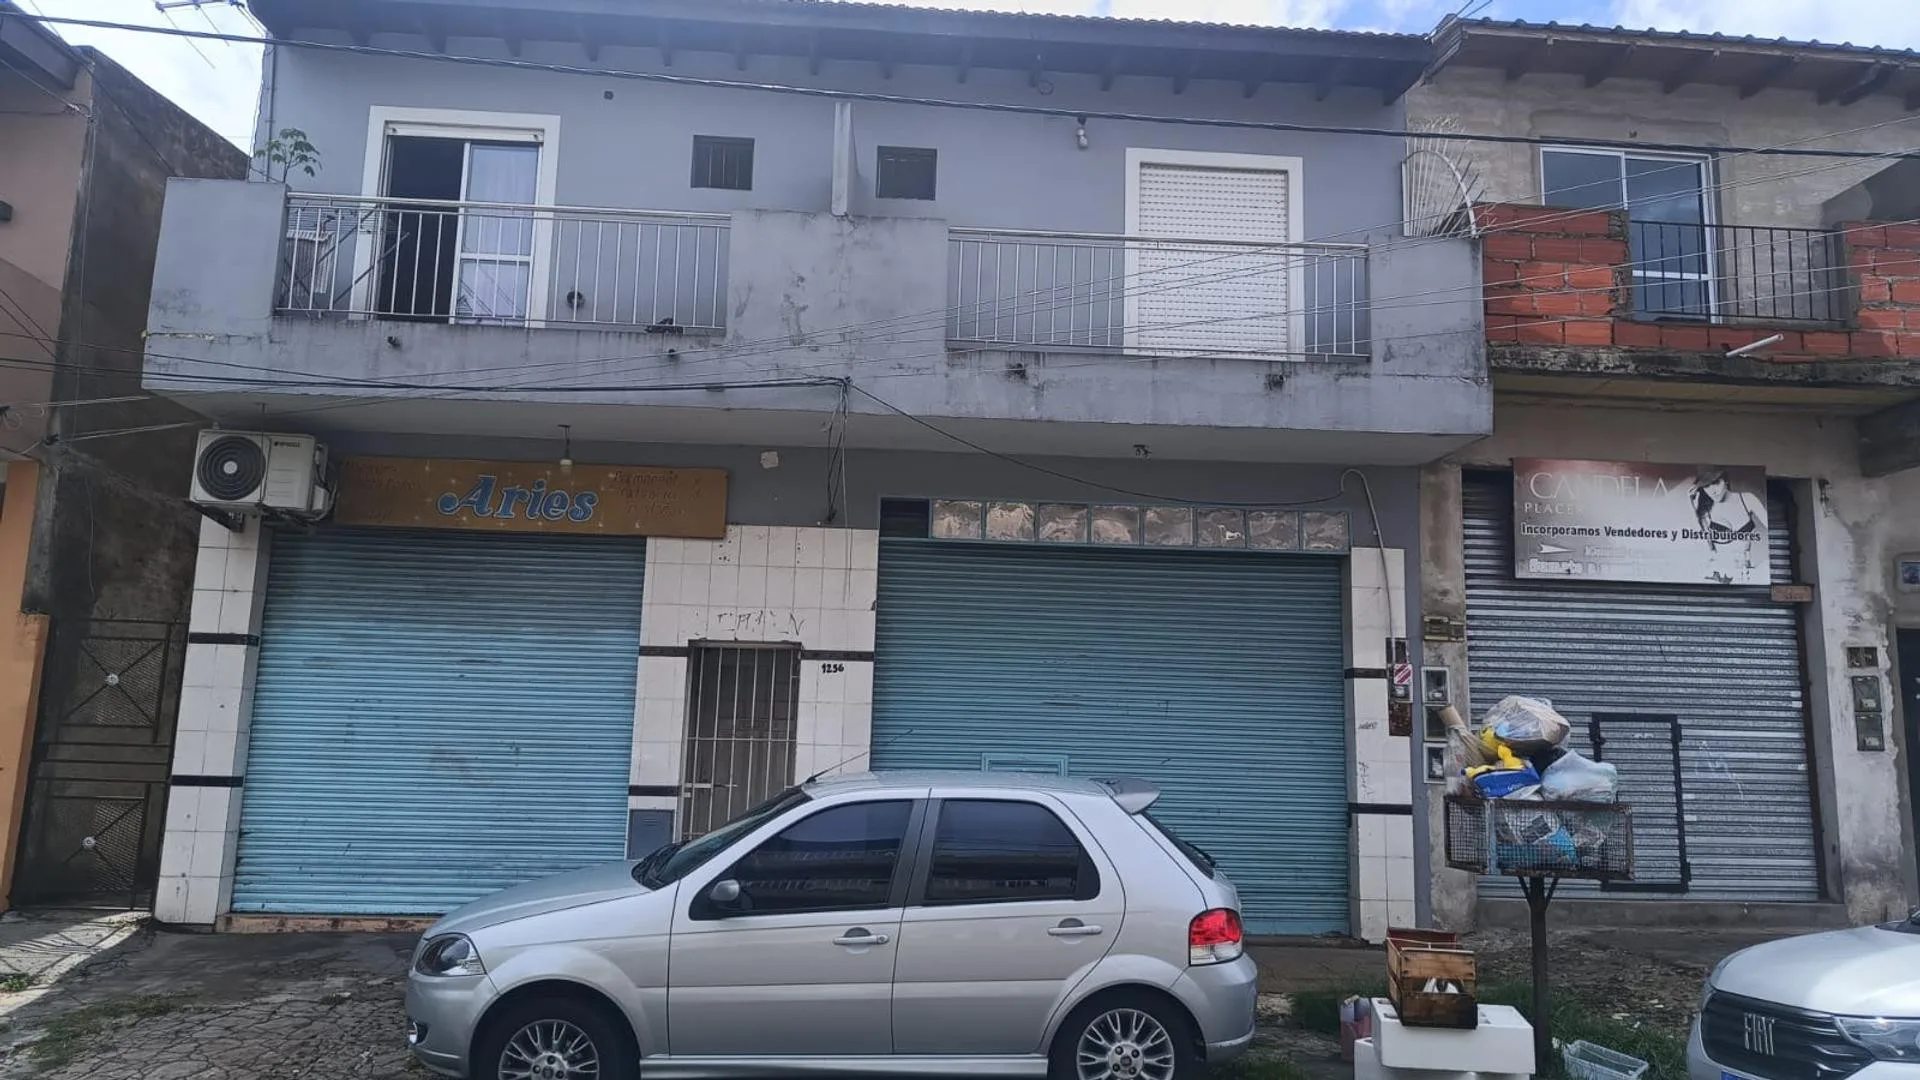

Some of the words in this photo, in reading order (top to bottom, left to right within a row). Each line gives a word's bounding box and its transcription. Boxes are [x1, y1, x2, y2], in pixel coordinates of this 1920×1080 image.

[435, 474, 600, 523] Aries
[1521, 523, 1600, 538] Incorporamos
[1604, 526, 1668, 539] Vendedores
[1670, 529, 1679, 541] y
[1681, 528, 1761, 542] Distribuidores
[1743, 1012, 1776, 1056] FIAT
